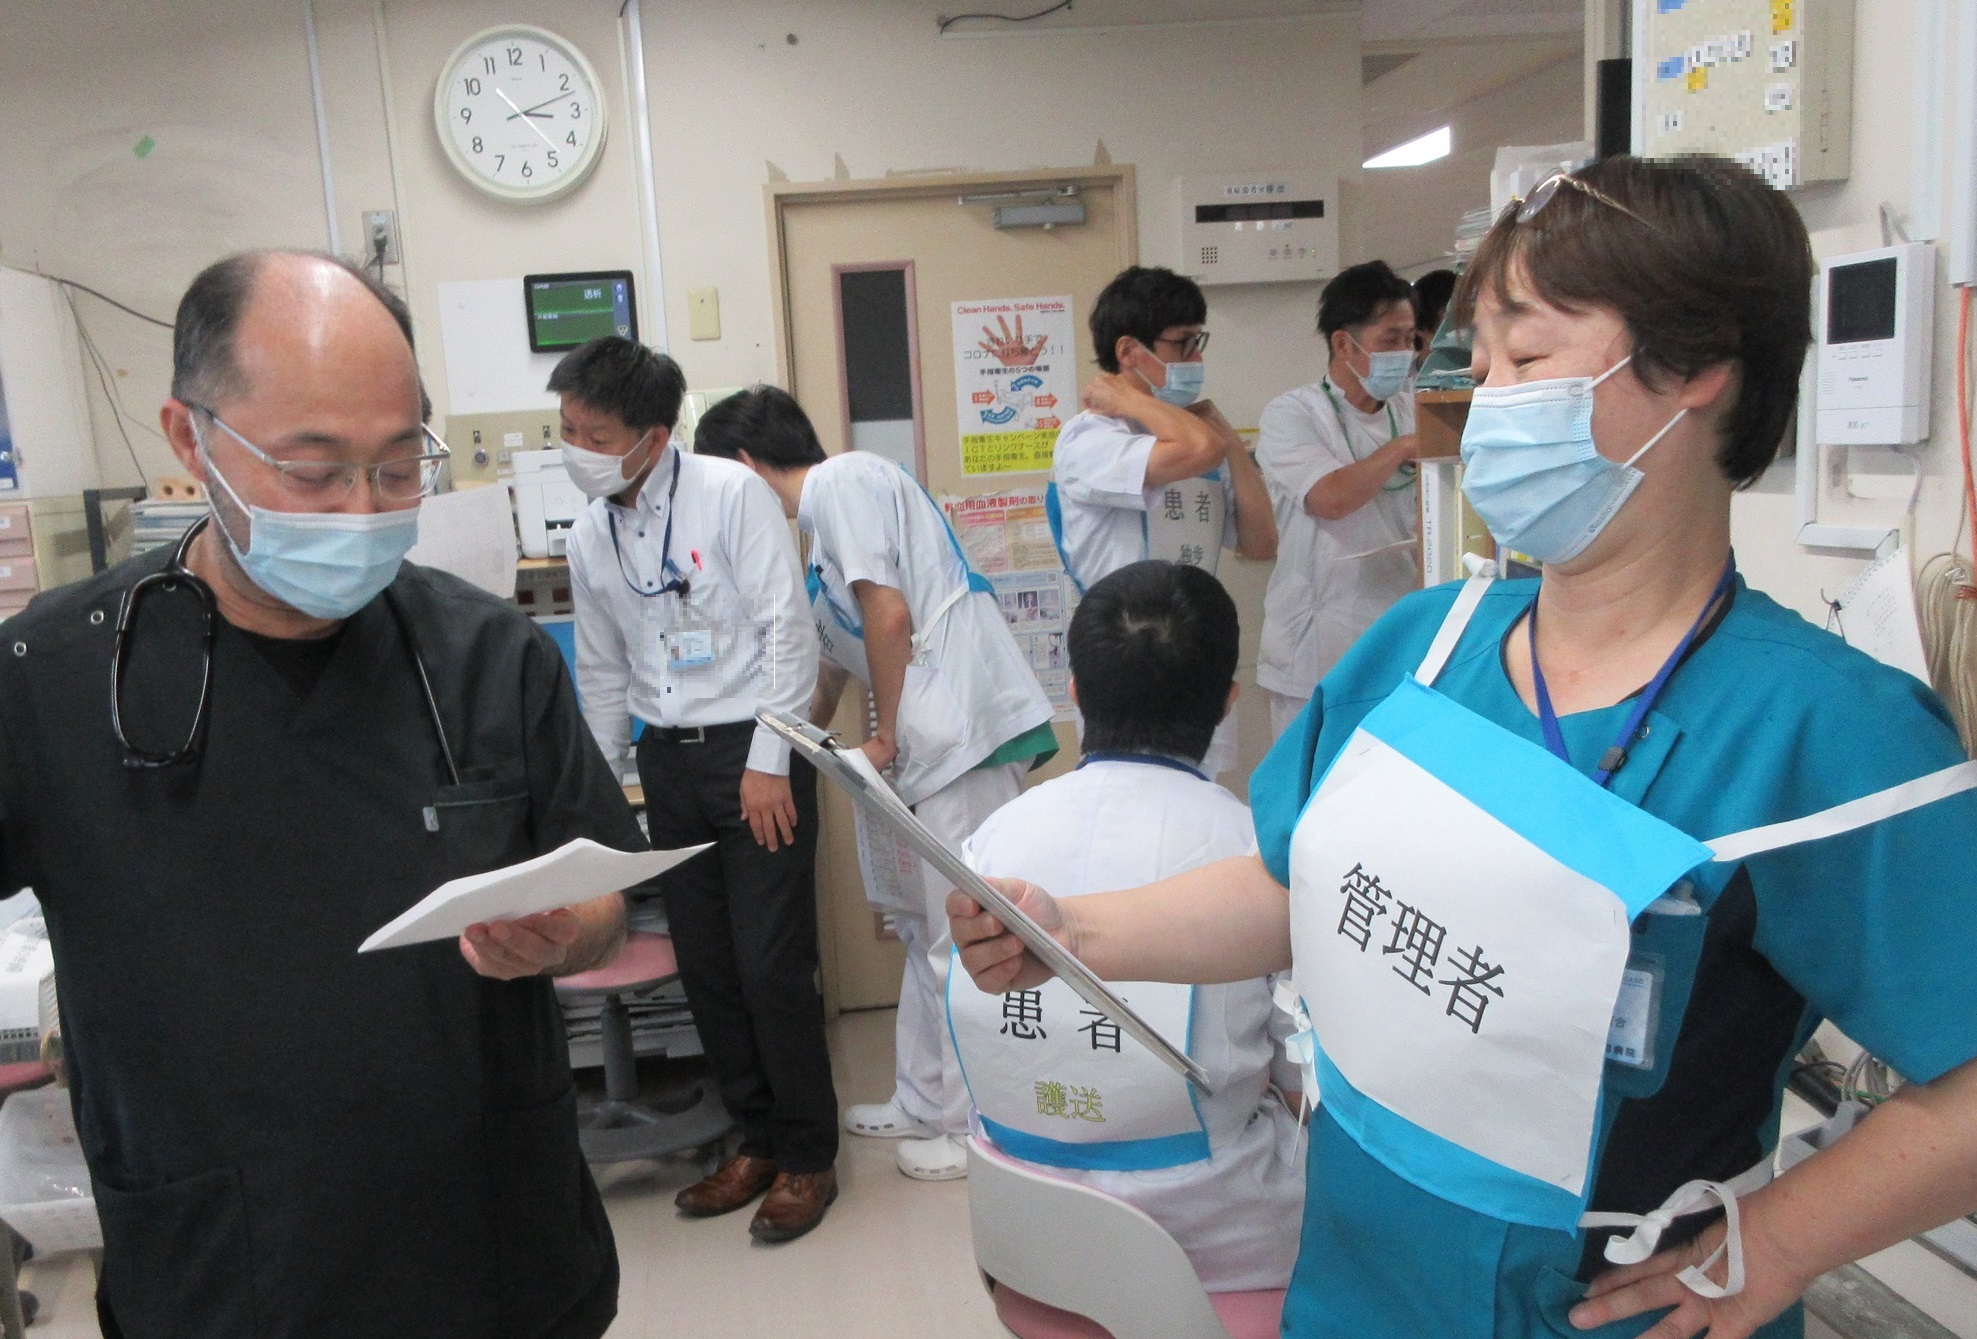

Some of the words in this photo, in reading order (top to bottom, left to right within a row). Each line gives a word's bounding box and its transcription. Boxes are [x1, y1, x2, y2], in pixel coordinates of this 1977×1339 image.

[506, 47, 523, 66] 12
[539, 54, 545, 72] 1
[483, 57, 496, 75] 11
[463, 78, 481, 96] 10
[558, 73, 570, 91] 2
[460, 107, 472, 125] 9
[569, 102, 581, 119] 3
[472, 136, 484, 154] 8
[565, 130, 577, 147] 4
[495, 154, 505, 172] 7
[546, 151, 559, 168] 5
[521, 160, 533, 178] 6
[957, 306, 982, 315] Clean
[1013, 302, 1035, 311] Safe
[1337, 861, 1505, 1035] 管理者
[1034, 1080, 1107, 1123] 護送
